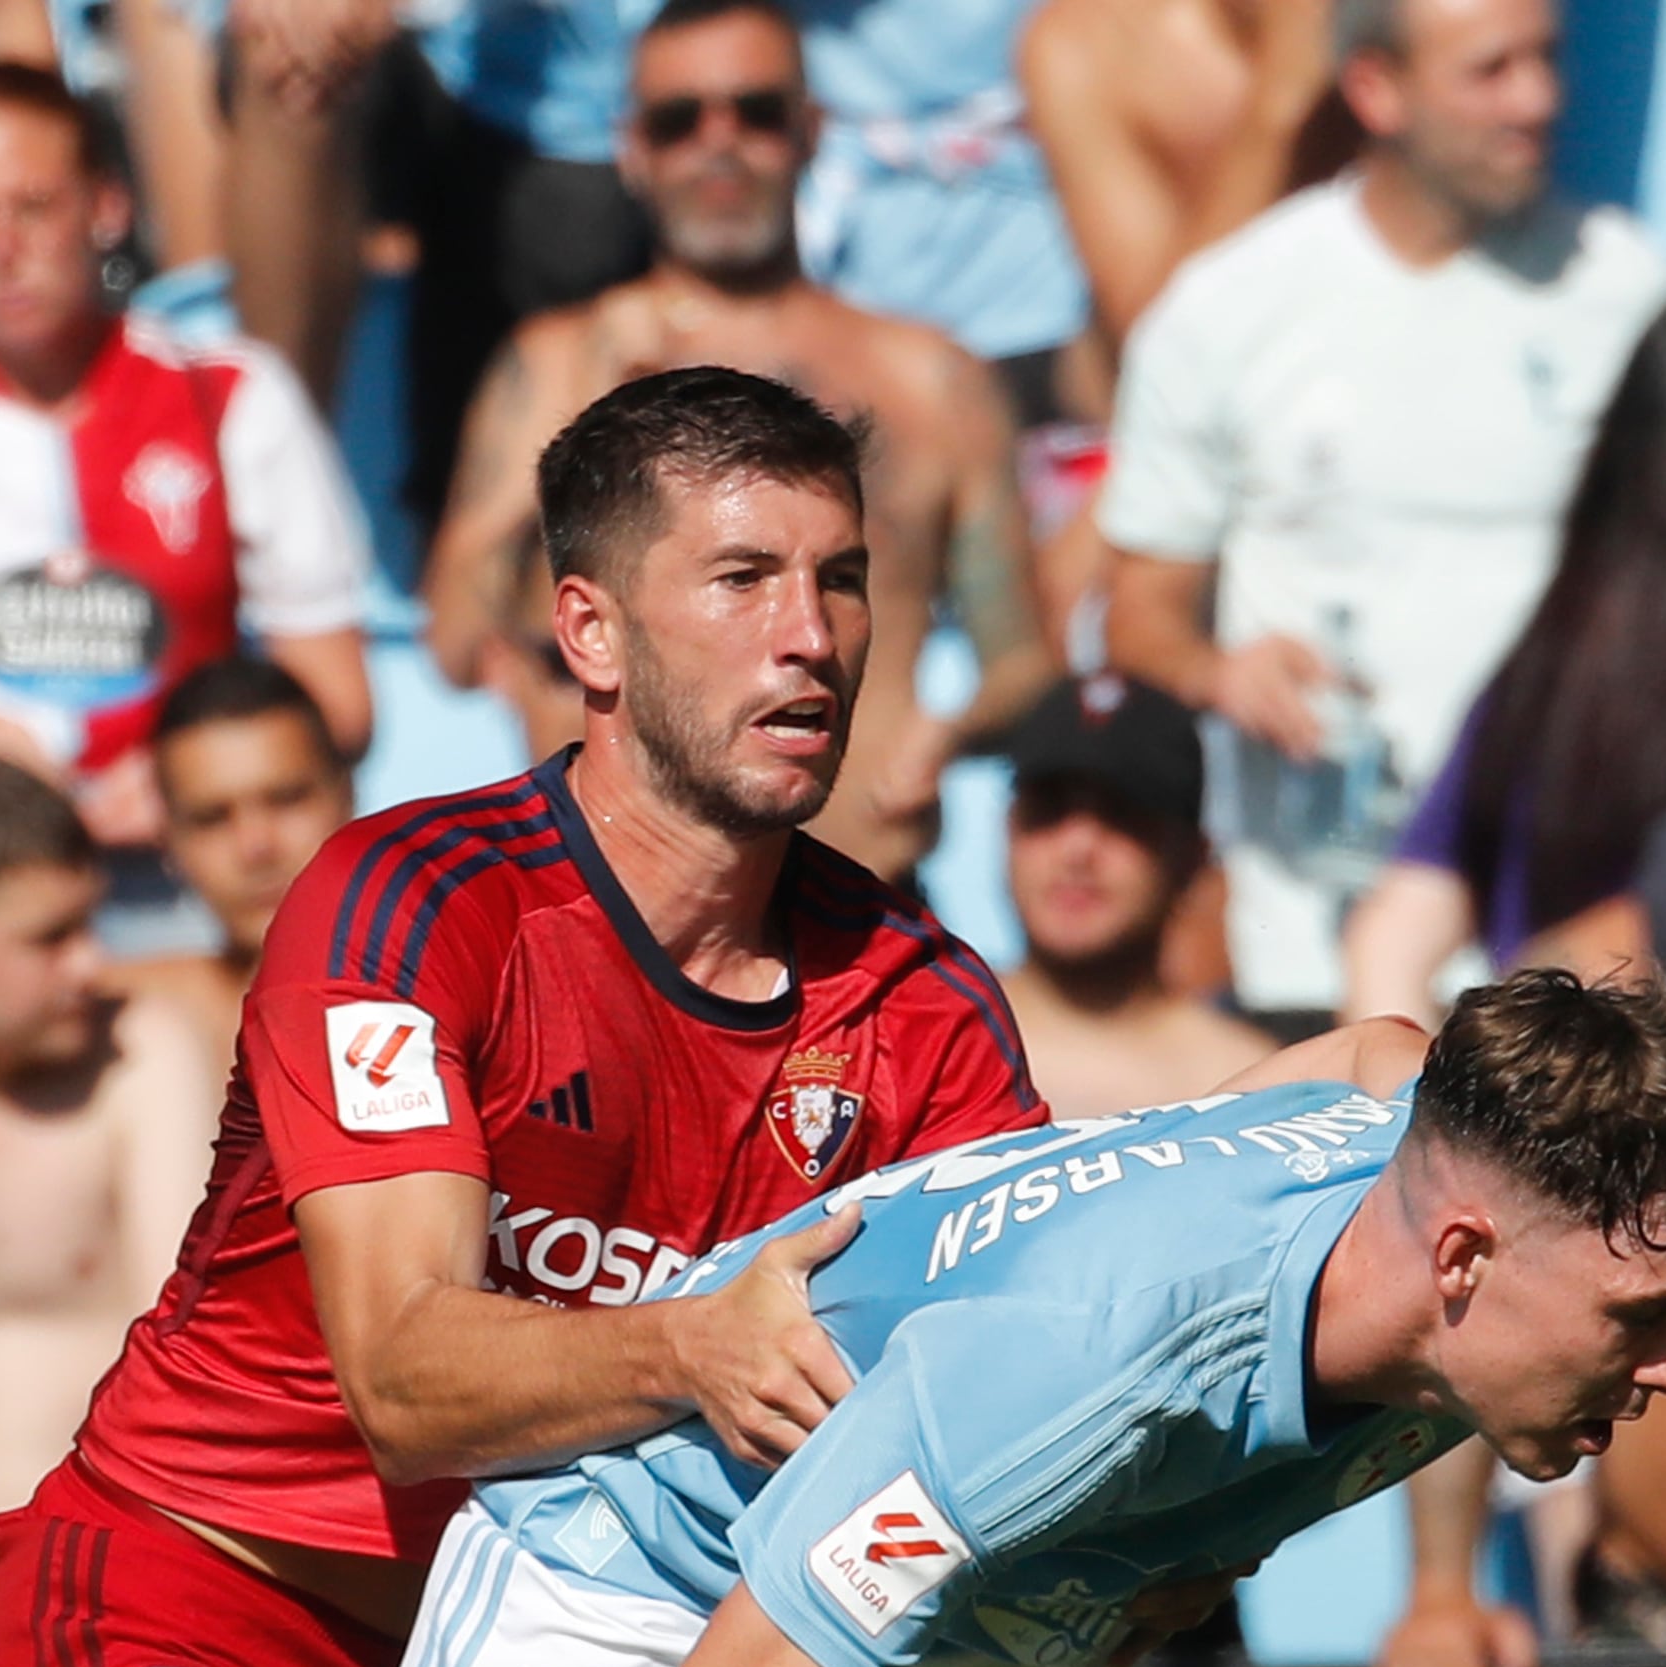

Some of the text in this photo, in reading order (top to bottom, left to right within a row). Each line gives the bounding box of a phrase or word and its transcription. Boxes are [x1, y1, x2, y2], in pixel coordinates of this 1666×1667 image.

[351, 1090, 433, 1121] LALIGA
[924, 1134, 1239, 1285] LARSEN
[829, 1544, 890, 1614] LALIGA
